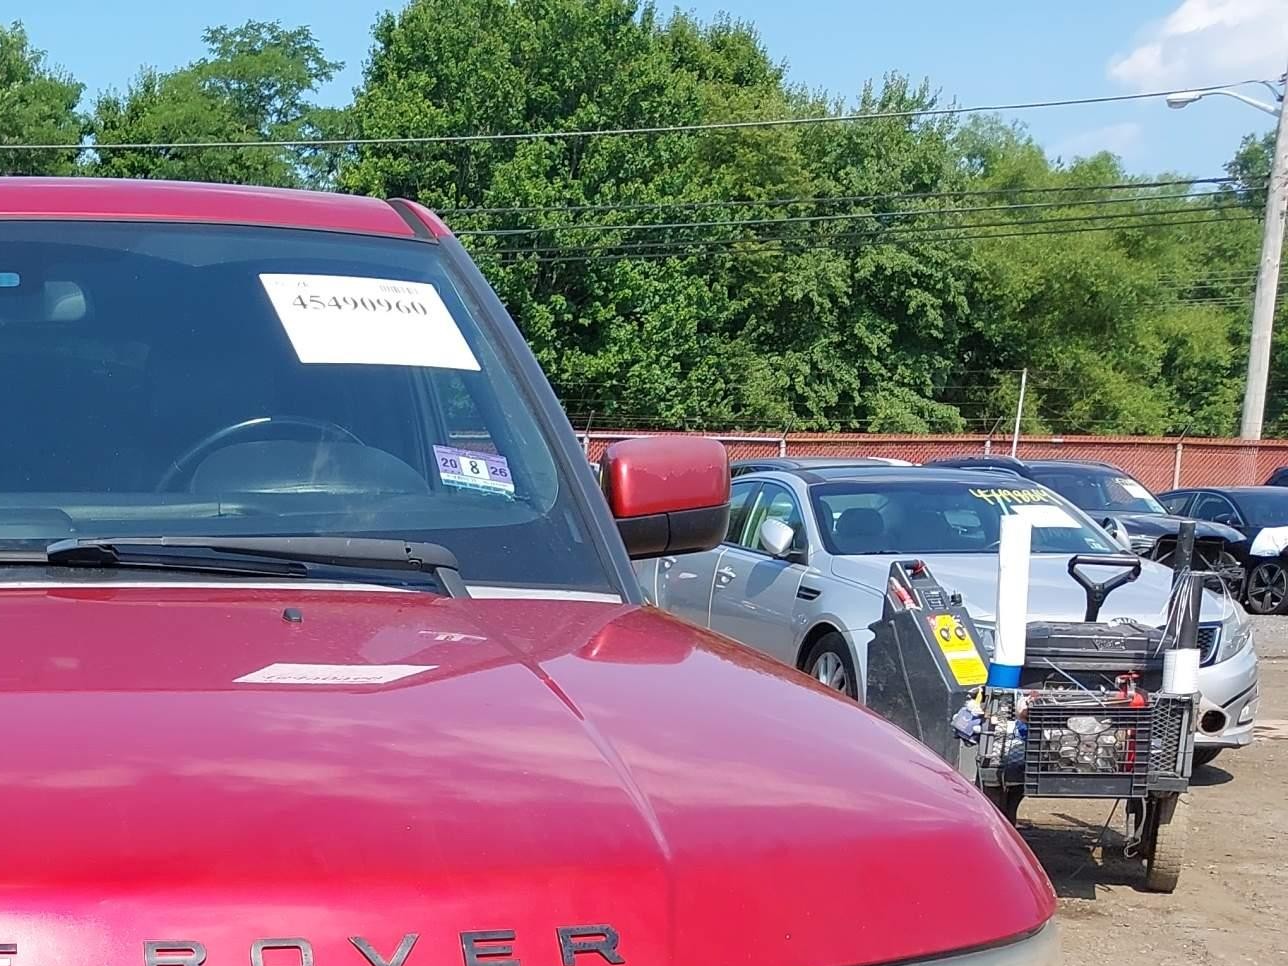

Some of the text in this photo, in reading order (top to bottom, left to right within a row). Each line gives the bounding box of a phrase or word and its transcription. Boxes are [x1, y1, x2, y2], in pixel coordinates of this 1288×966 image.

[292, 294, 428, 316] 45490960
[441, 457, 509, 478] 20 8 26
